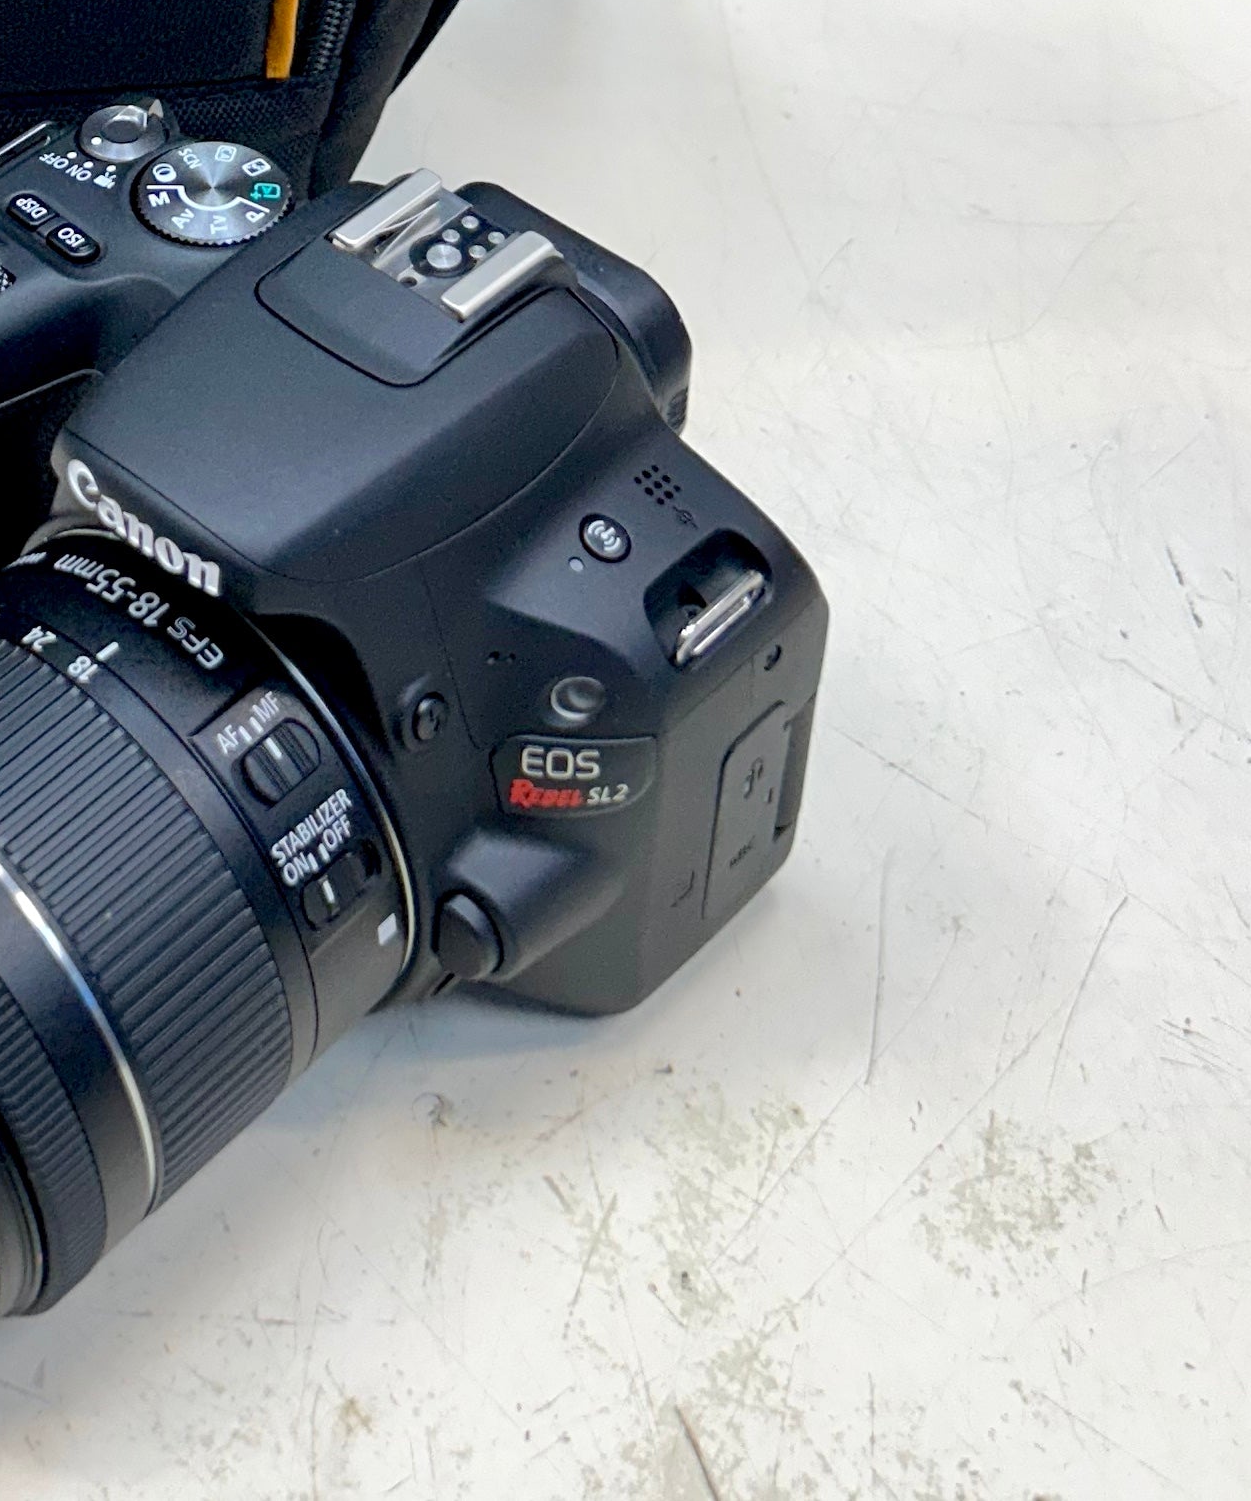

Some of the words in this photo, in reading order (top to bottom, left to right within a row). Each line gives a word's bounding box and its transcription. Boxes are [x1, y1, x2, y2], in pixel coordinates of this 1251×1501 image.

[39, 152, 69, 169] OFF
[178, 147, 203, 169] SCN
[65, 164, 92, 181] ON
[15, 198, 47, 218] DISP
[148, 191, 170, 207] M
[245, 210, 265, 223] P
[57, 227, 85, 247] ISO
[66, 459, 222, 597] Canon
[53, 554, 170, 627] 18-55mm
[21, 626, 57, 652] 24
[67, 655, 98, 684] 18
[216, 724, 240, 755] AF
[252, 691, 280, 723] MF
[521, 745, 601, 780] EOS
[587, 783, 629, 806] SL2
[270, 788, 353, 867] STABILIZER
[281, 851, 310, 886] ON
[322, 814, 351, 849] OFF
